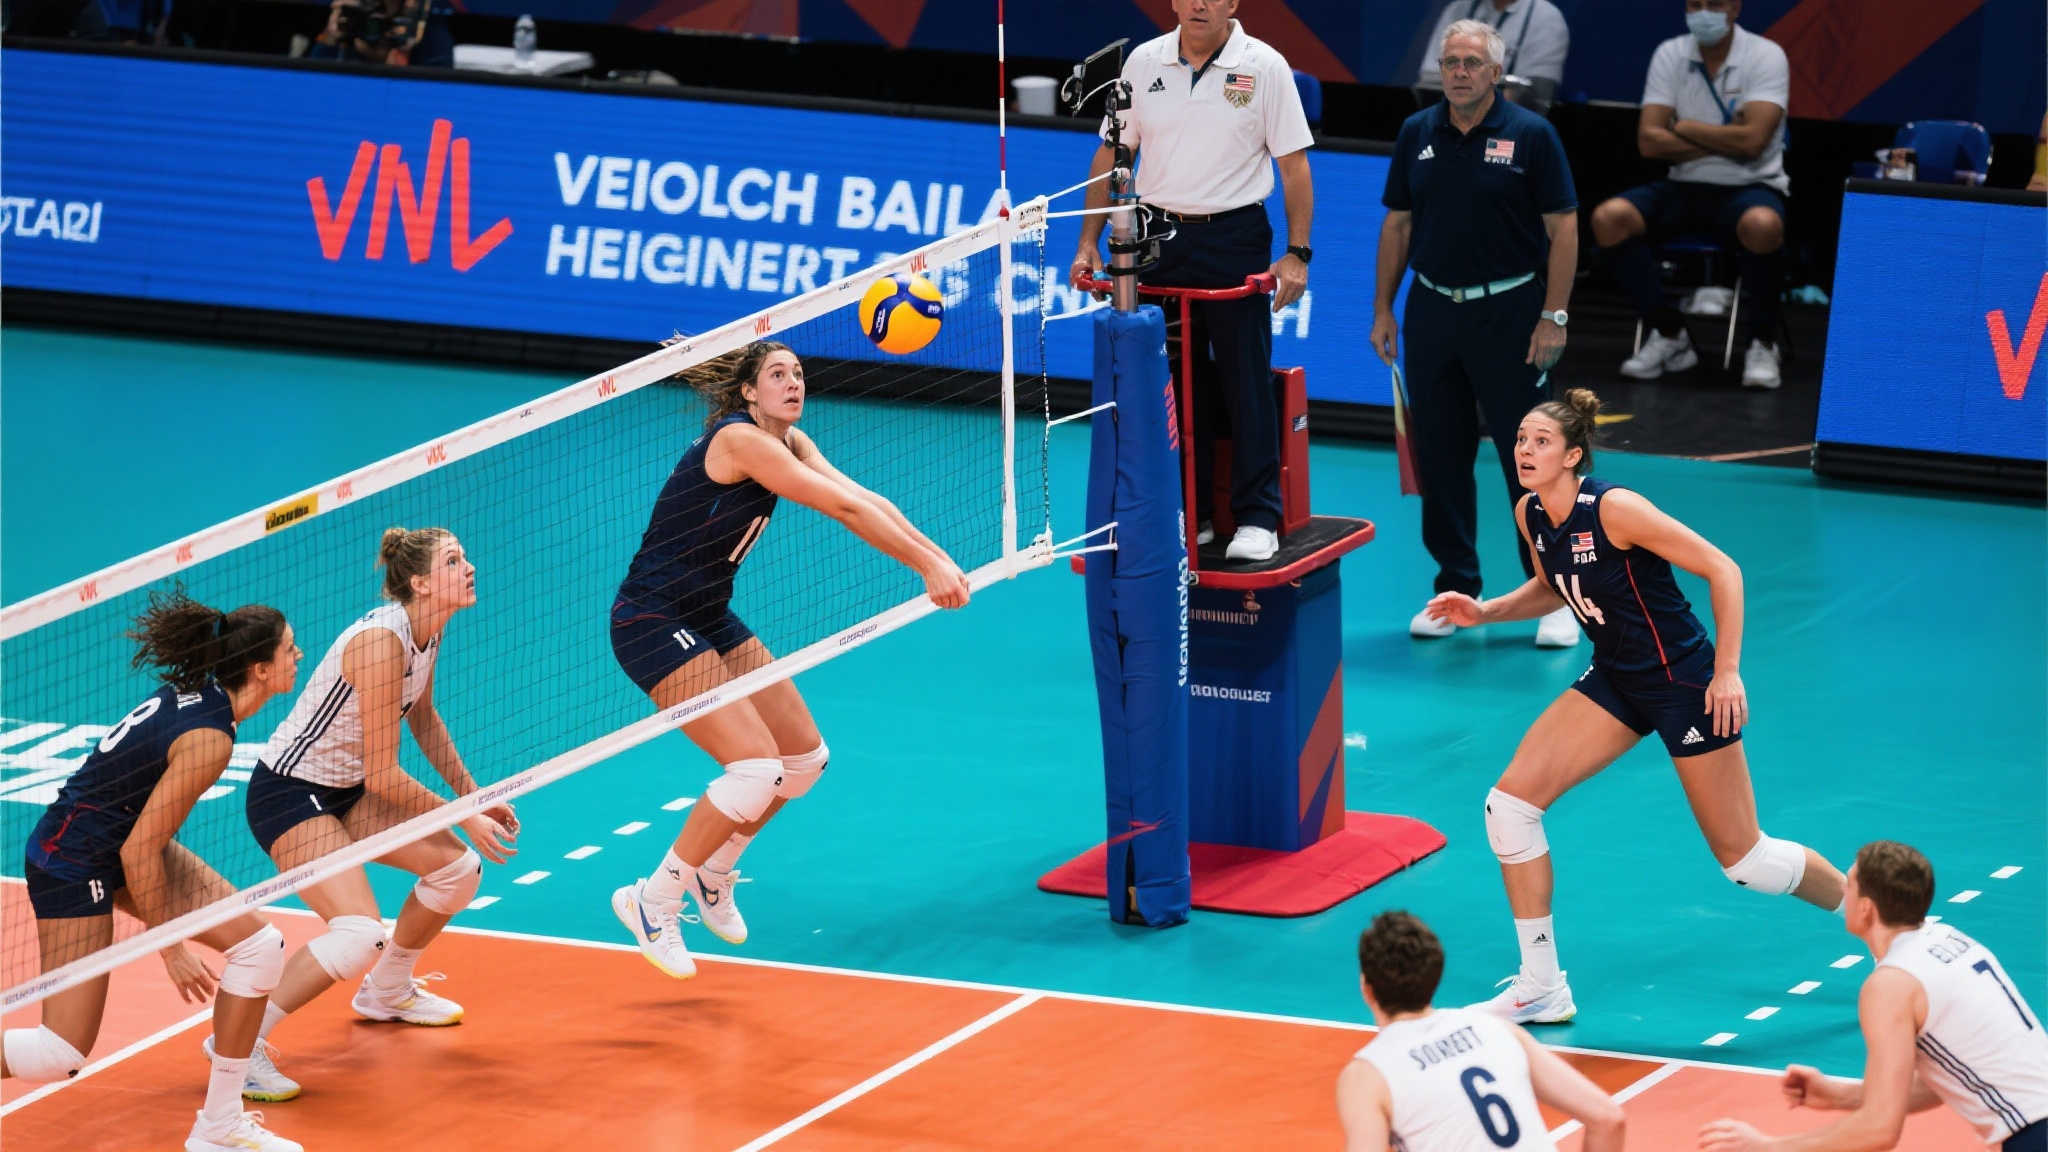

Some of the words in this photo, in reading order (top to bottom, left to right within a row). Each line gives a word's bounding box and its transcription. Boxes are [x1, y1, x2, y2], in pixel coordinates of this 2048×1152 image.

[307, 118, 514, 272] VNL
[554, 151, 819, 226] VEIOLCH
[1554, 573, 1606, 625] 14
[99, 697, 162, 753] 8
[1460, 1066, 1521, 1149] 6
